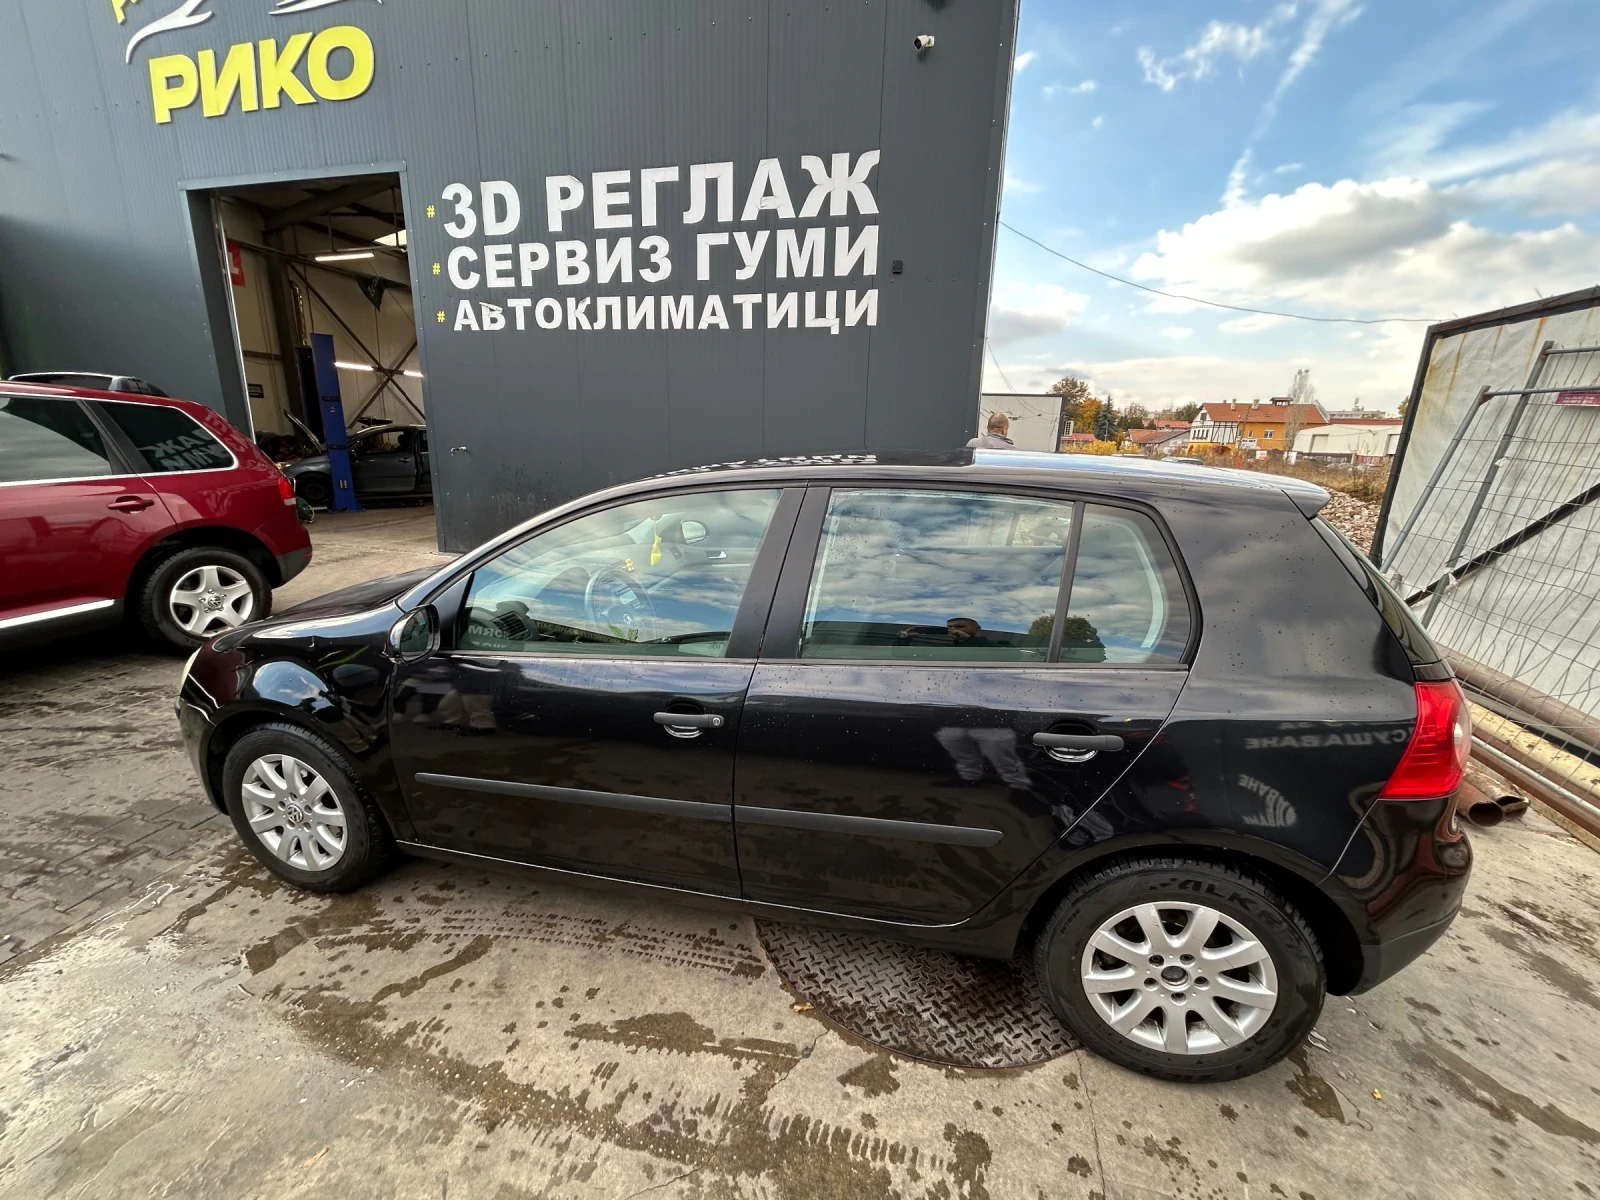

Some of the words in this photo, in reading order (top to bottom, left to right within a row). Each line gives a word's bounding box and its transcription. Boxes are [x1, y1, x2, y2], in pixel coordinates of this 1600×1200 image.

[148, 25, 375, 124] РИКО
[442, 180, 521, 238] 3D
[546, 149, 881, 232] РЕГЛАЖ
[447, 235, 672, 290] СЕРВИЗ
[697, 225, 879, 281] ГУМИ
[453, 289, 879, 335] АВТОКЛИМАТИЦИ
